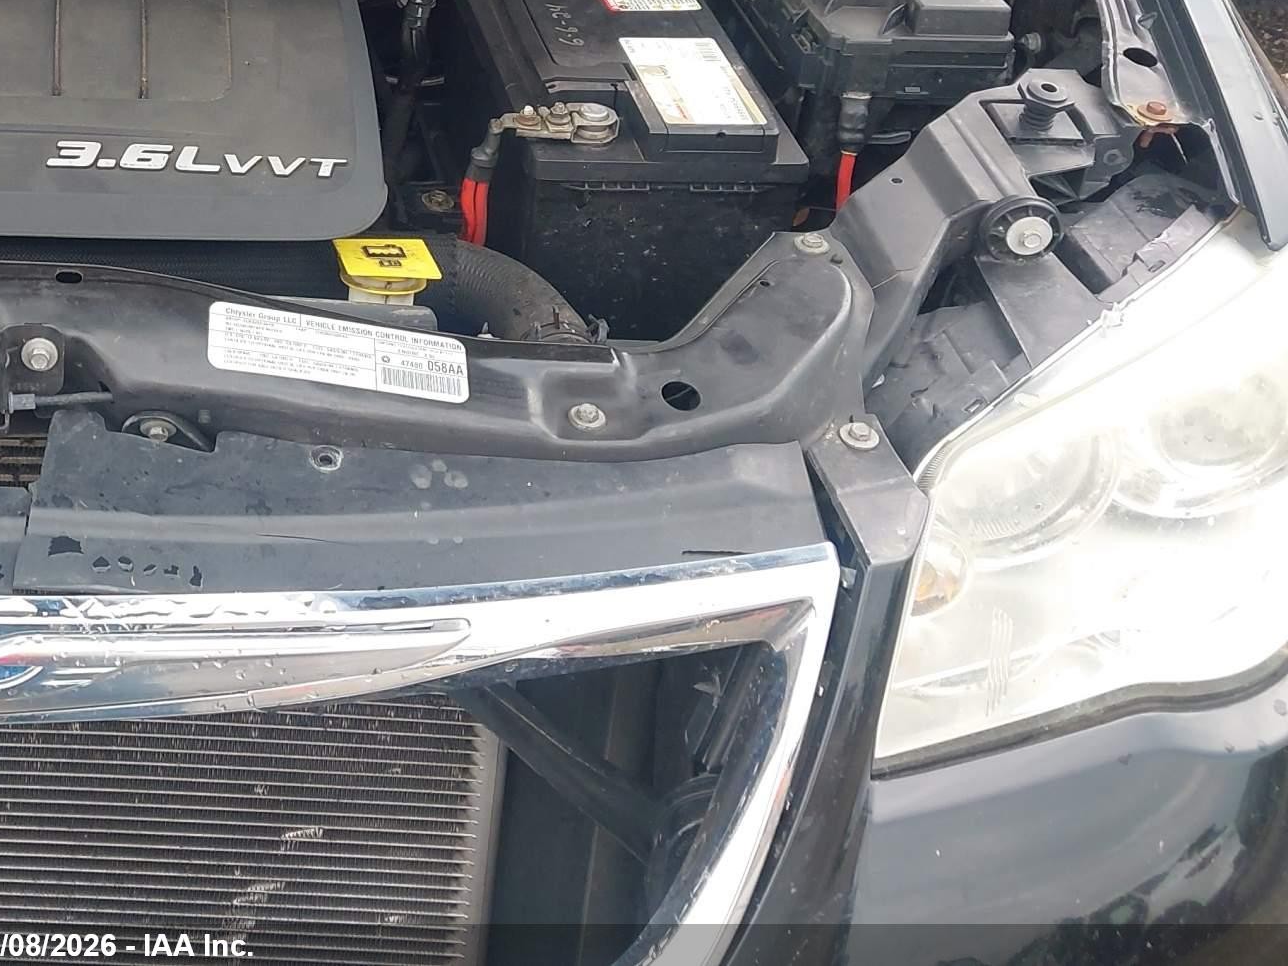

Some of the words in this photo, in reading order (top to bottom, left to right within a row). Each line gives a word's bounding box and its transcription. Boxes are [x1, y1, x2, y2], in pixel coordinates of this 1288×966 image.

[46, 140, 221, 173] 3.6L
[223, 153, 348, 178] VVT
[225, 307, 256, 318] Chrysler
[258, 312, 281, 322] Group
[283, 315, 297, 324] LLC
[306, 320, 335, 331] VEHICLE
[339, 325, 373, 337] EMISSION
[375, 331, 409, 343] CONTROL
[411, 337, 462, 351] INFORMATION
